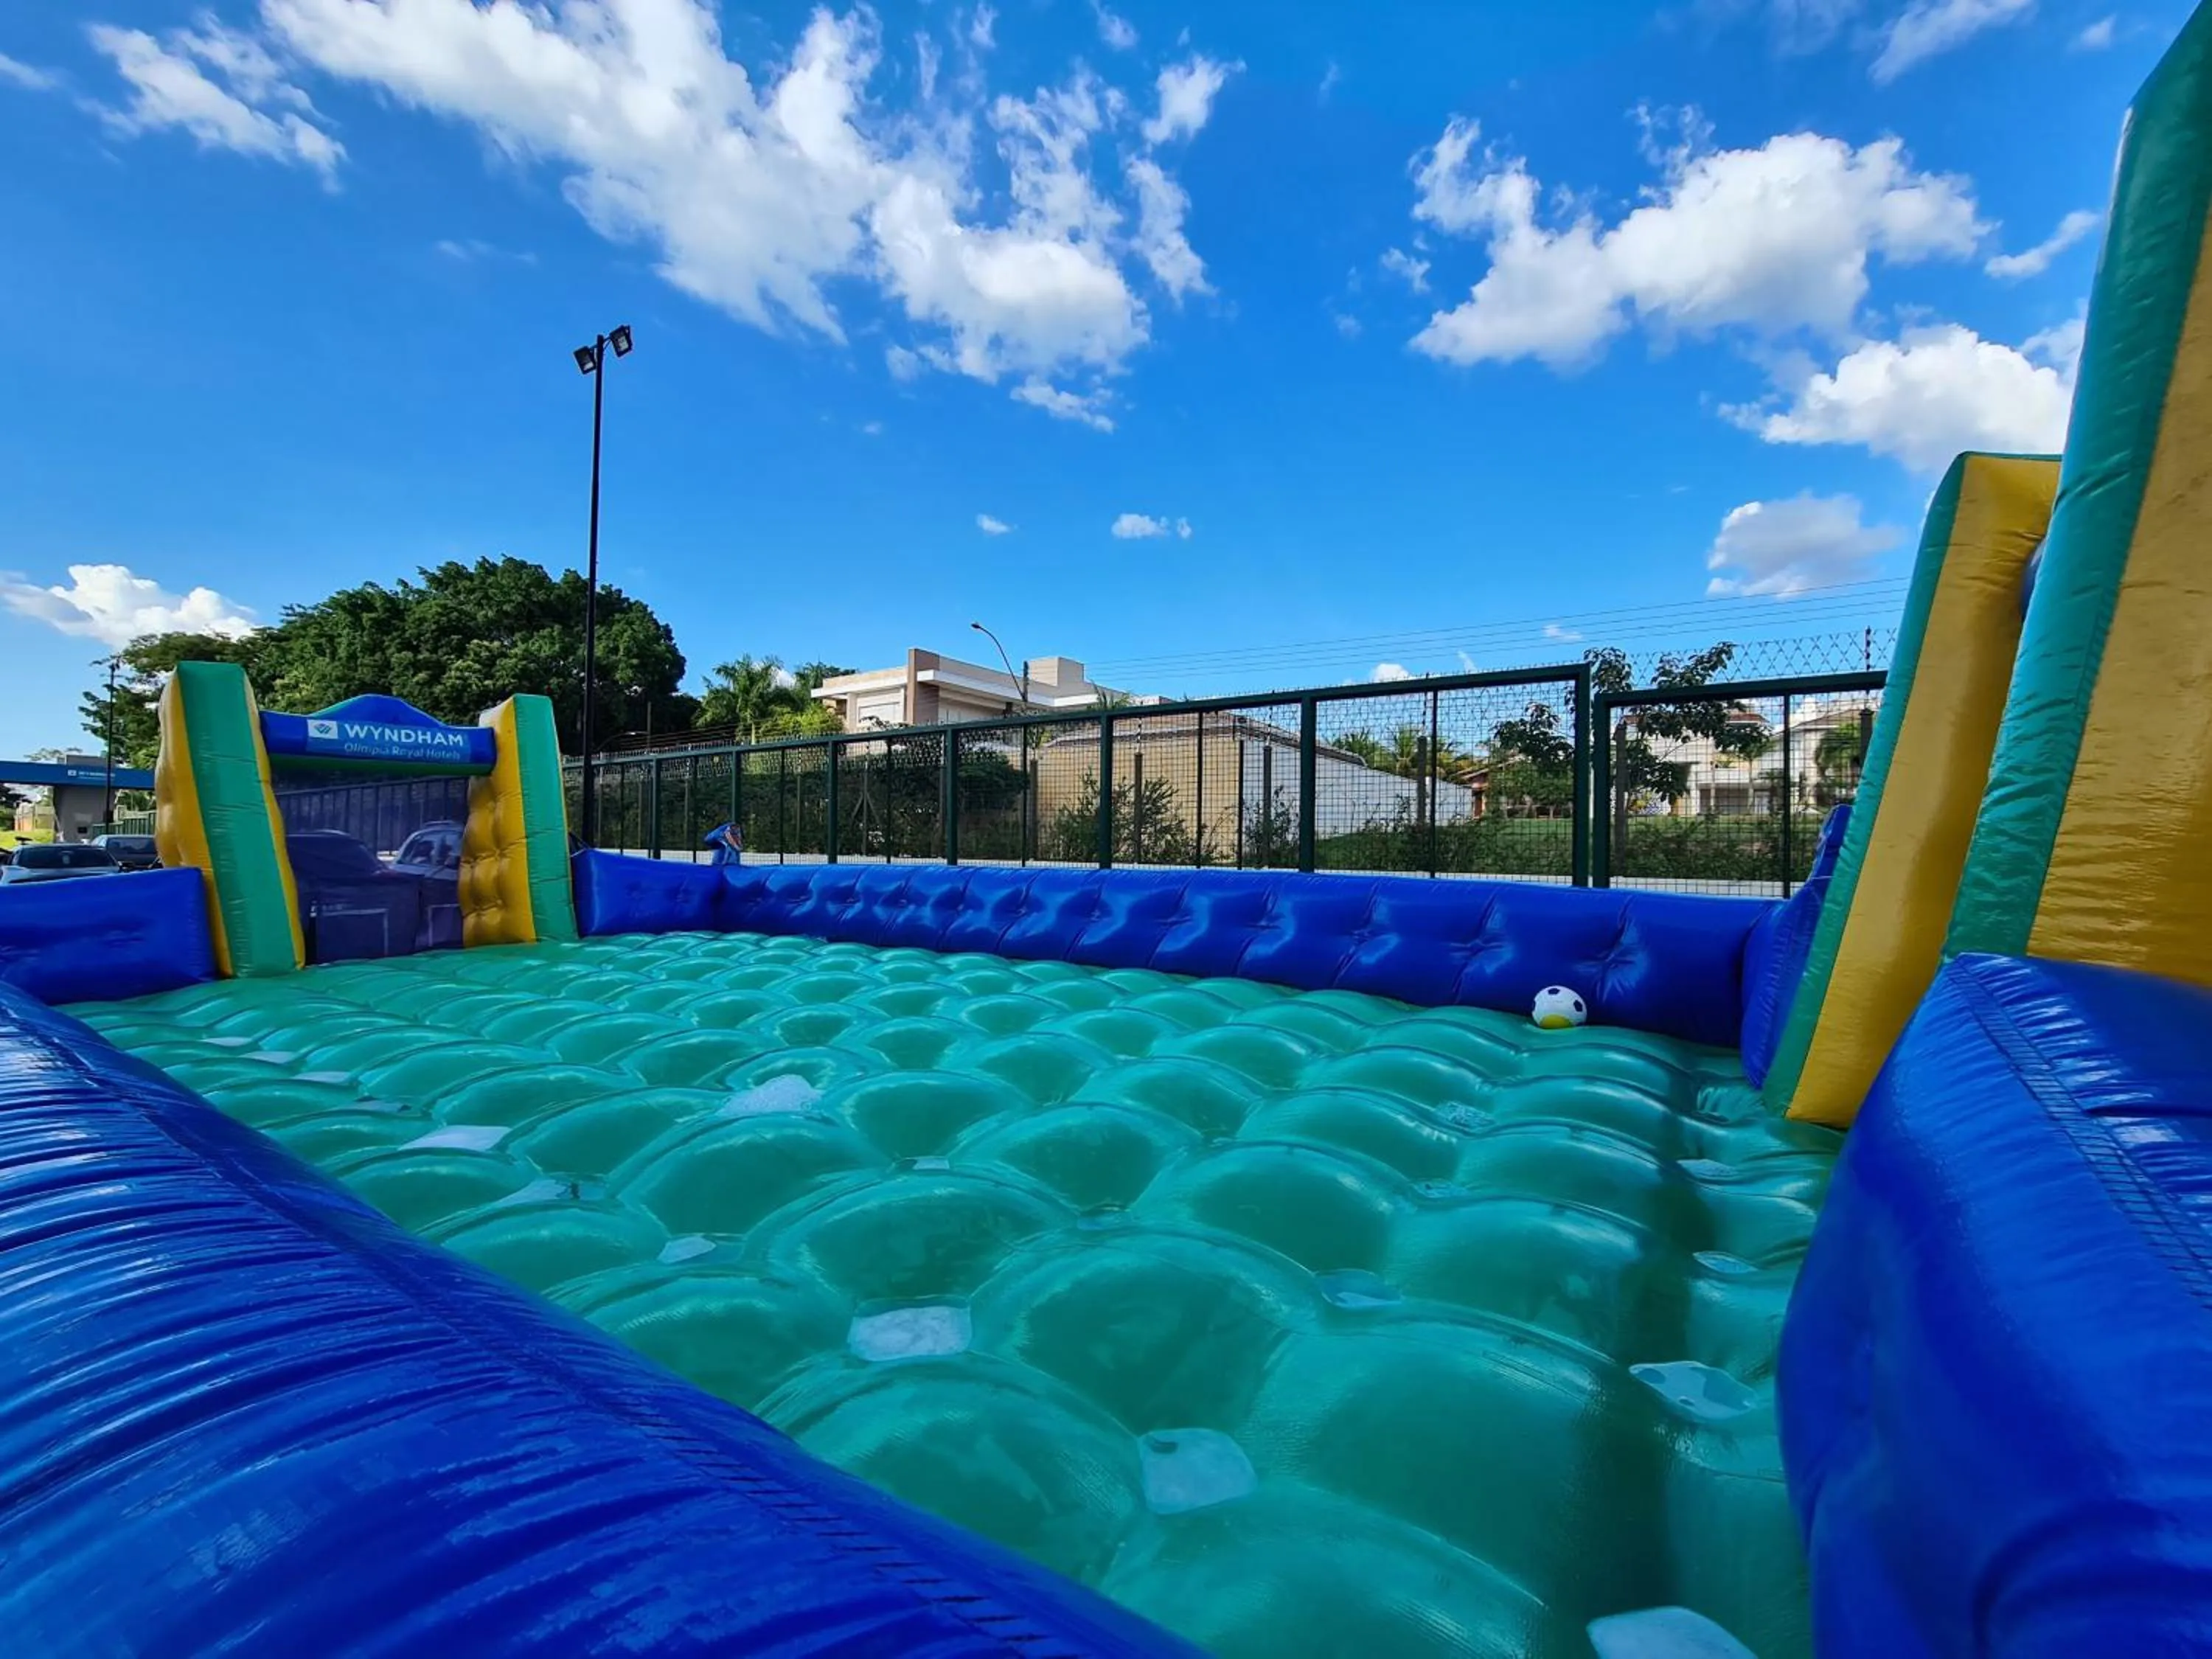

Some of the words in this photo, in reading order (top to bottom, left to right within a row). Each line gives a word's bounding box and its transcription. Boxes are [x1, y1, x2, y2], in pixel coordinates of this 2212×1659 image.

[344, 723, 463, 746] WYNDHAM
[344, 742, 389, 756] Olimpia
[392, 745, 424, 759] Royal
[427, 748, 461, 759] Hotels
